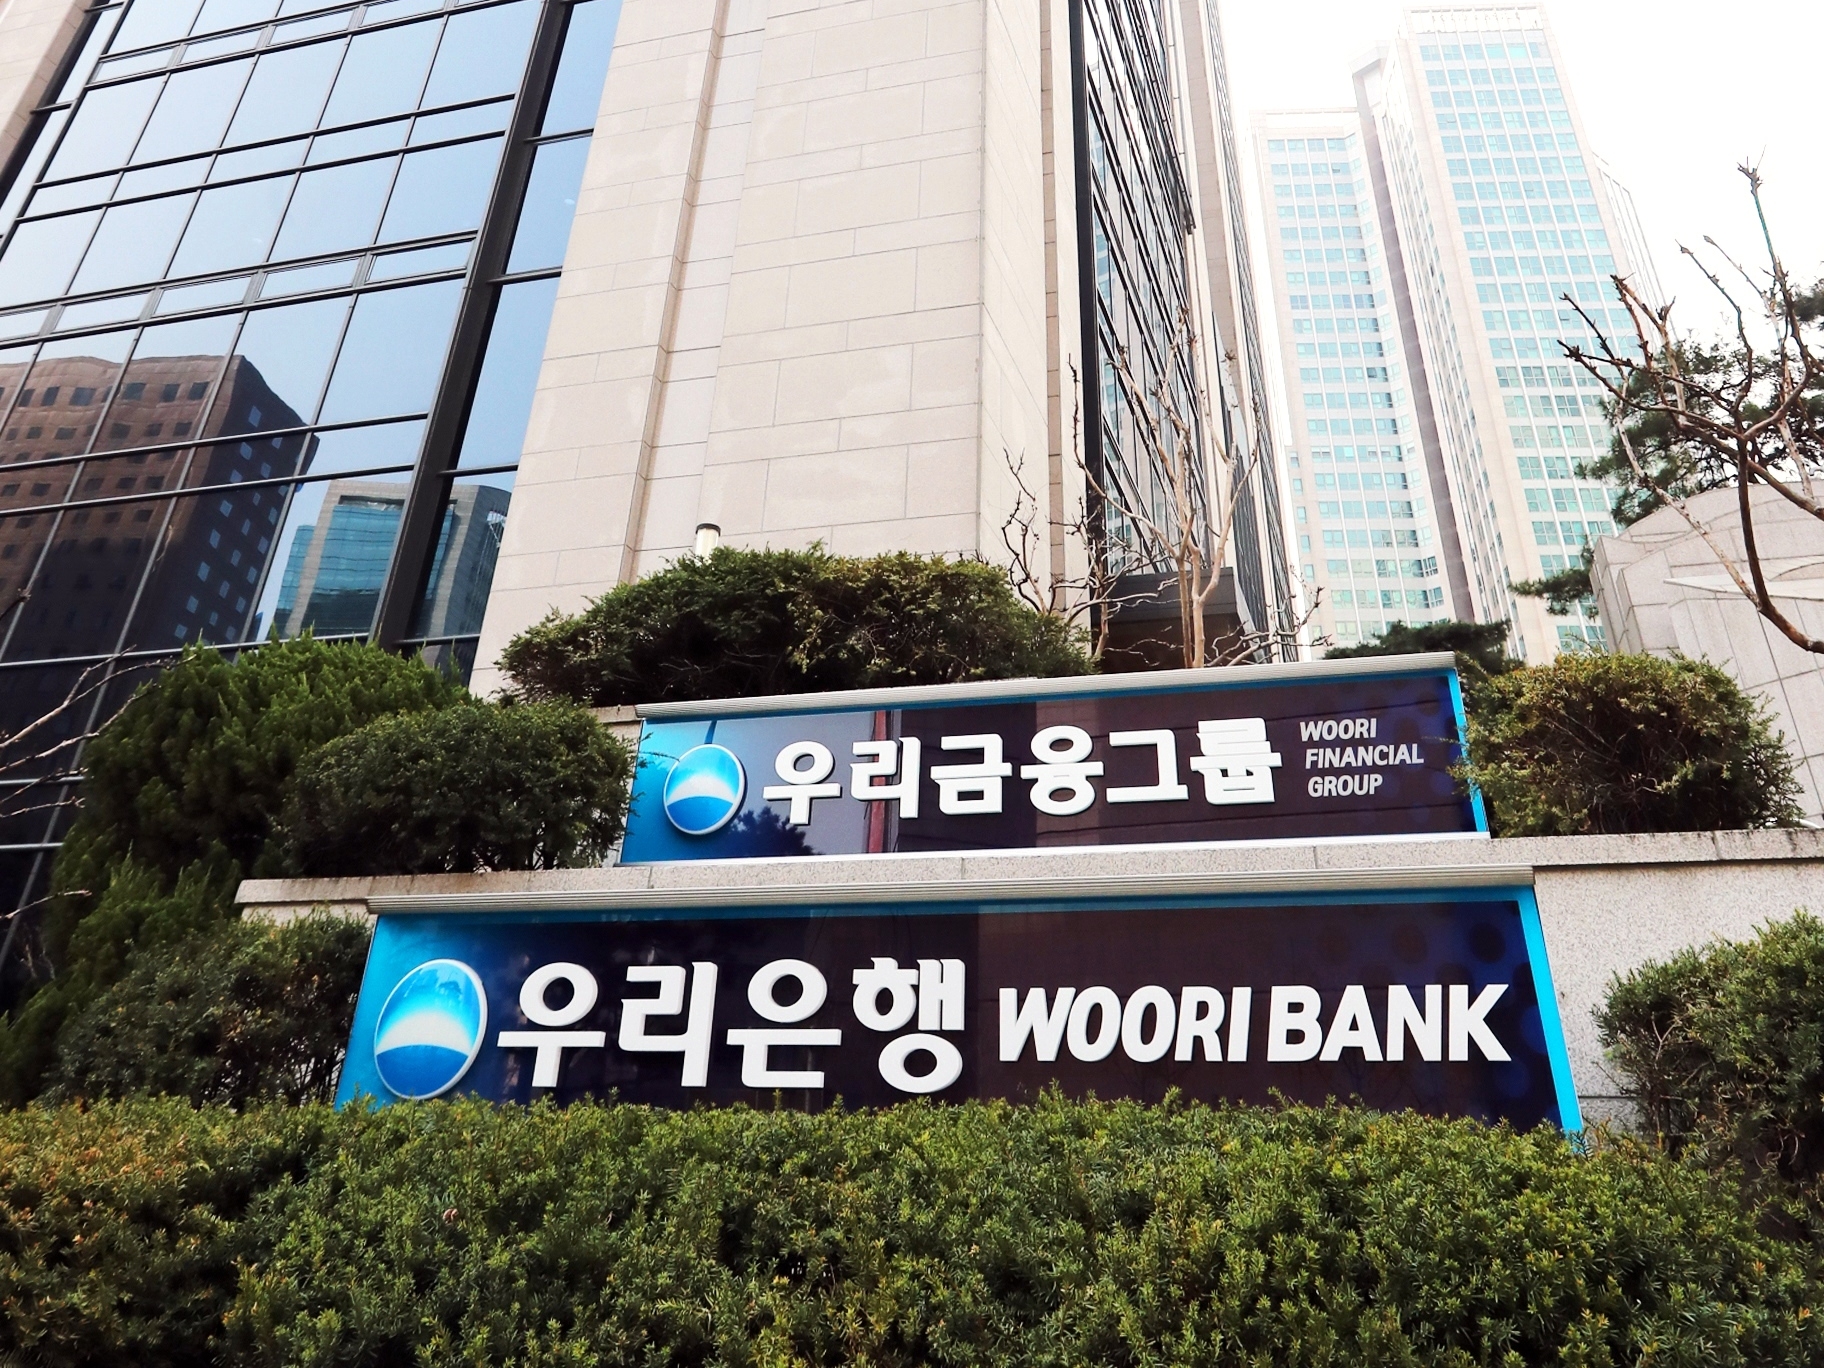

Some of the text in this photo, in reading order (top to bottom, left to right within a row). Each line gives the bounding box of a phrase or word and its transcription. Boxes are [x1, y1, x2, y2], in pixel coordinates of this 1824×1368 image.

[1299, 718, 1377, 742] WOORI
[1305, 743, 1425, 769] FINANCIAL
[762, 718, 1283, 825] 우리금융그룹
[1307, 773, 1383, 798] GROUP
[497, 957, 967, 1095] 우리은행
[999, 983, 1512, 1063] WOORI BANK
